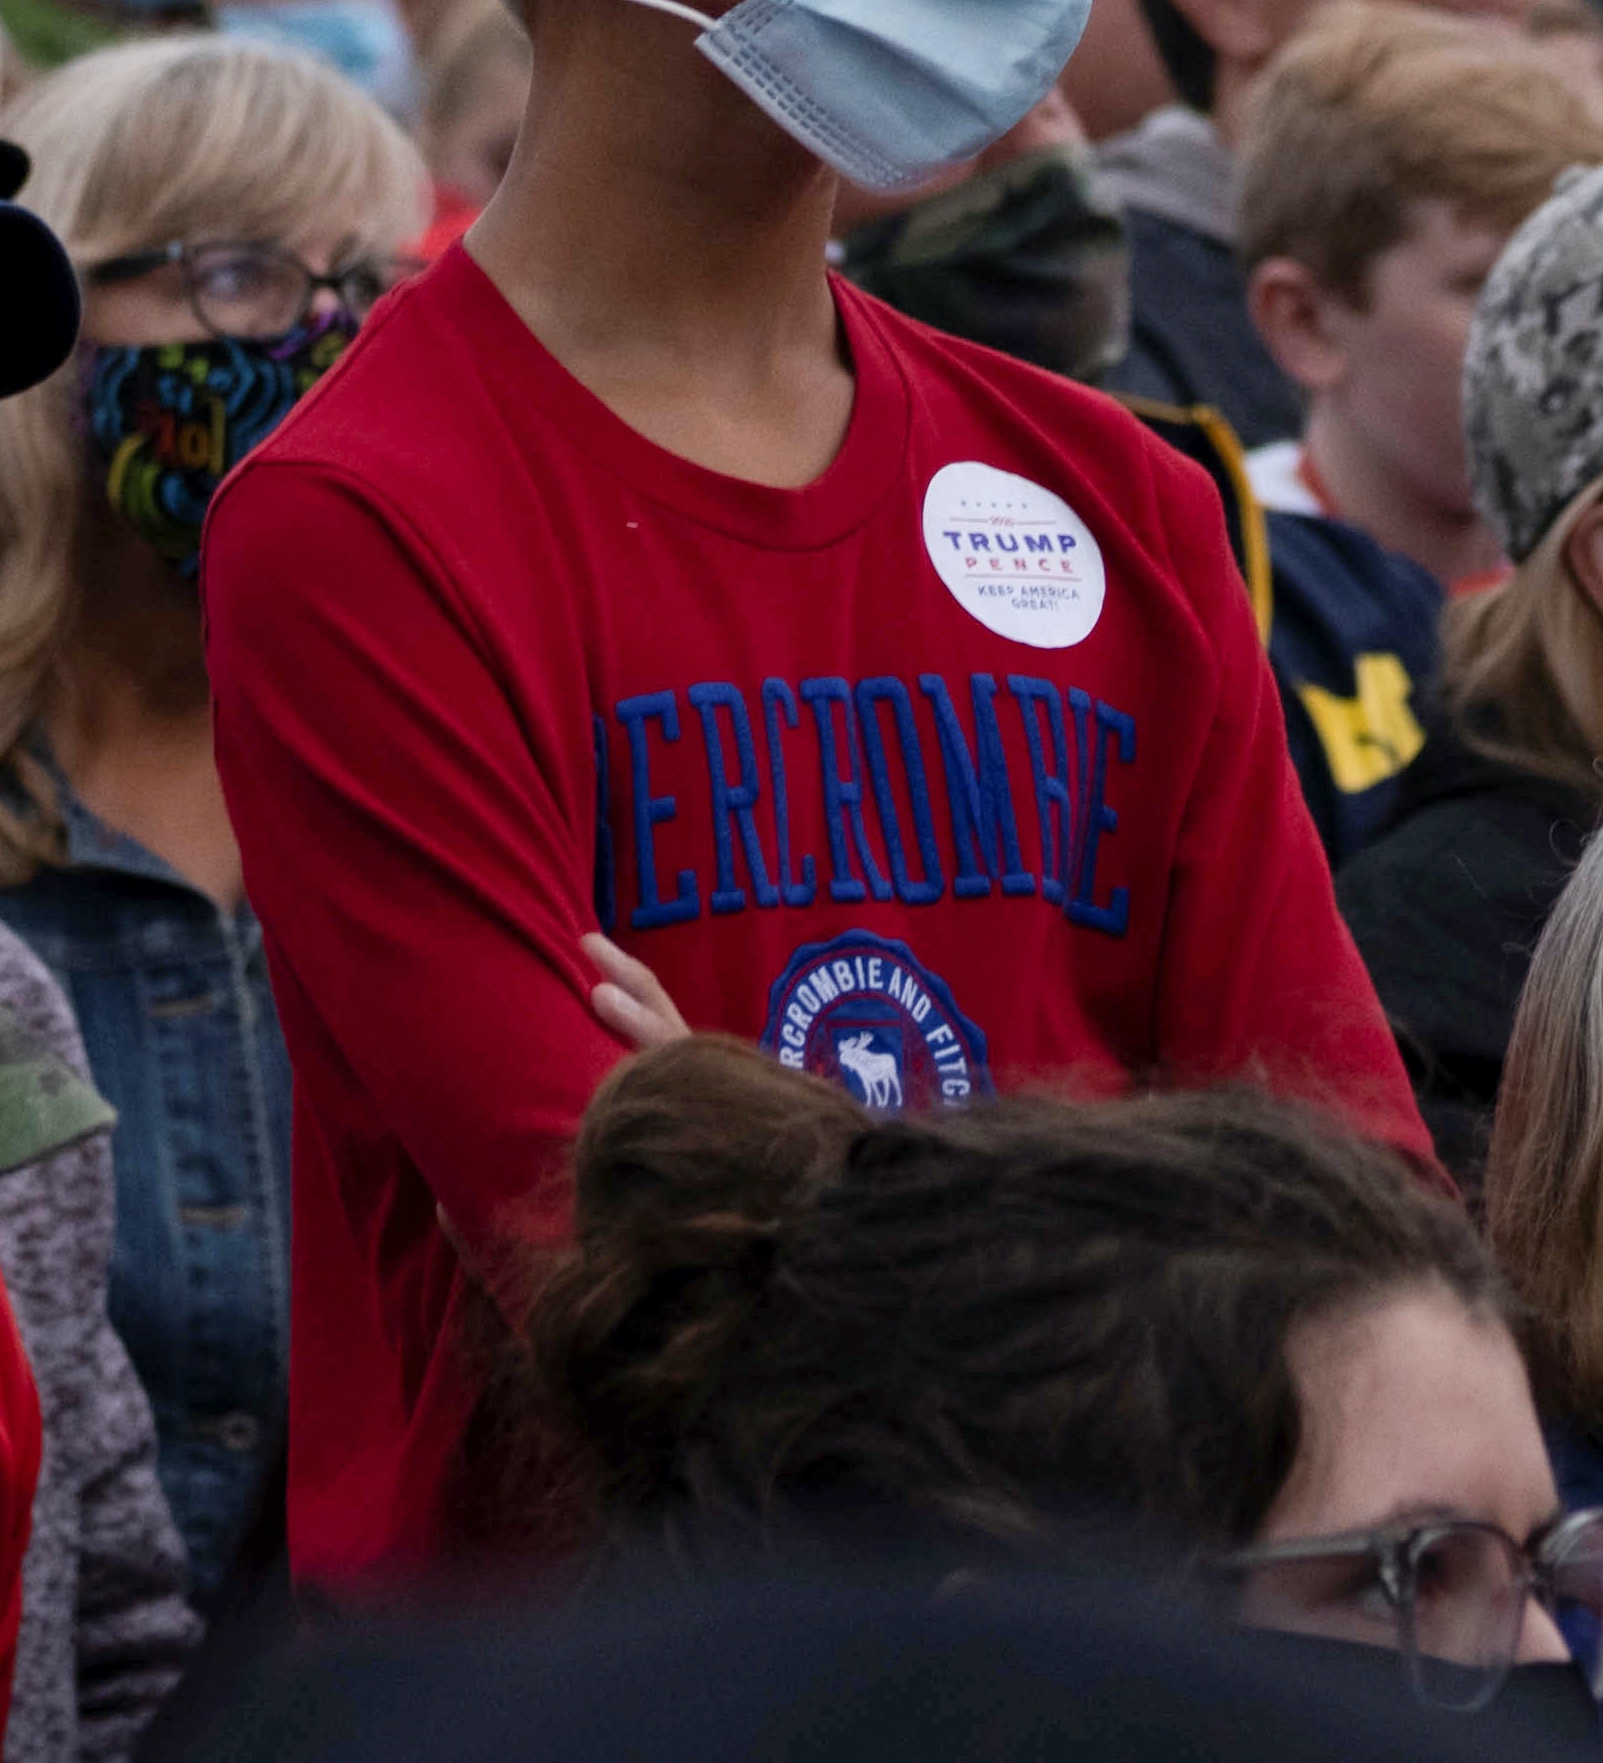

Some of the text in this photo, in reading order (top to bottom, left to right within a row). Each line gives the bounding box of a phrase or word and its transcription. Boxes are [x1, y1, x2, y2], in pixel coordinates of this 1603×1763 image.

[942, 530, 1077, 553] TRUMP
[964, 556, 1074, 572] PENCE
[977, 585, 1081, 601] KEEP AMERICA
[887, 966, 933, 1024] AND
